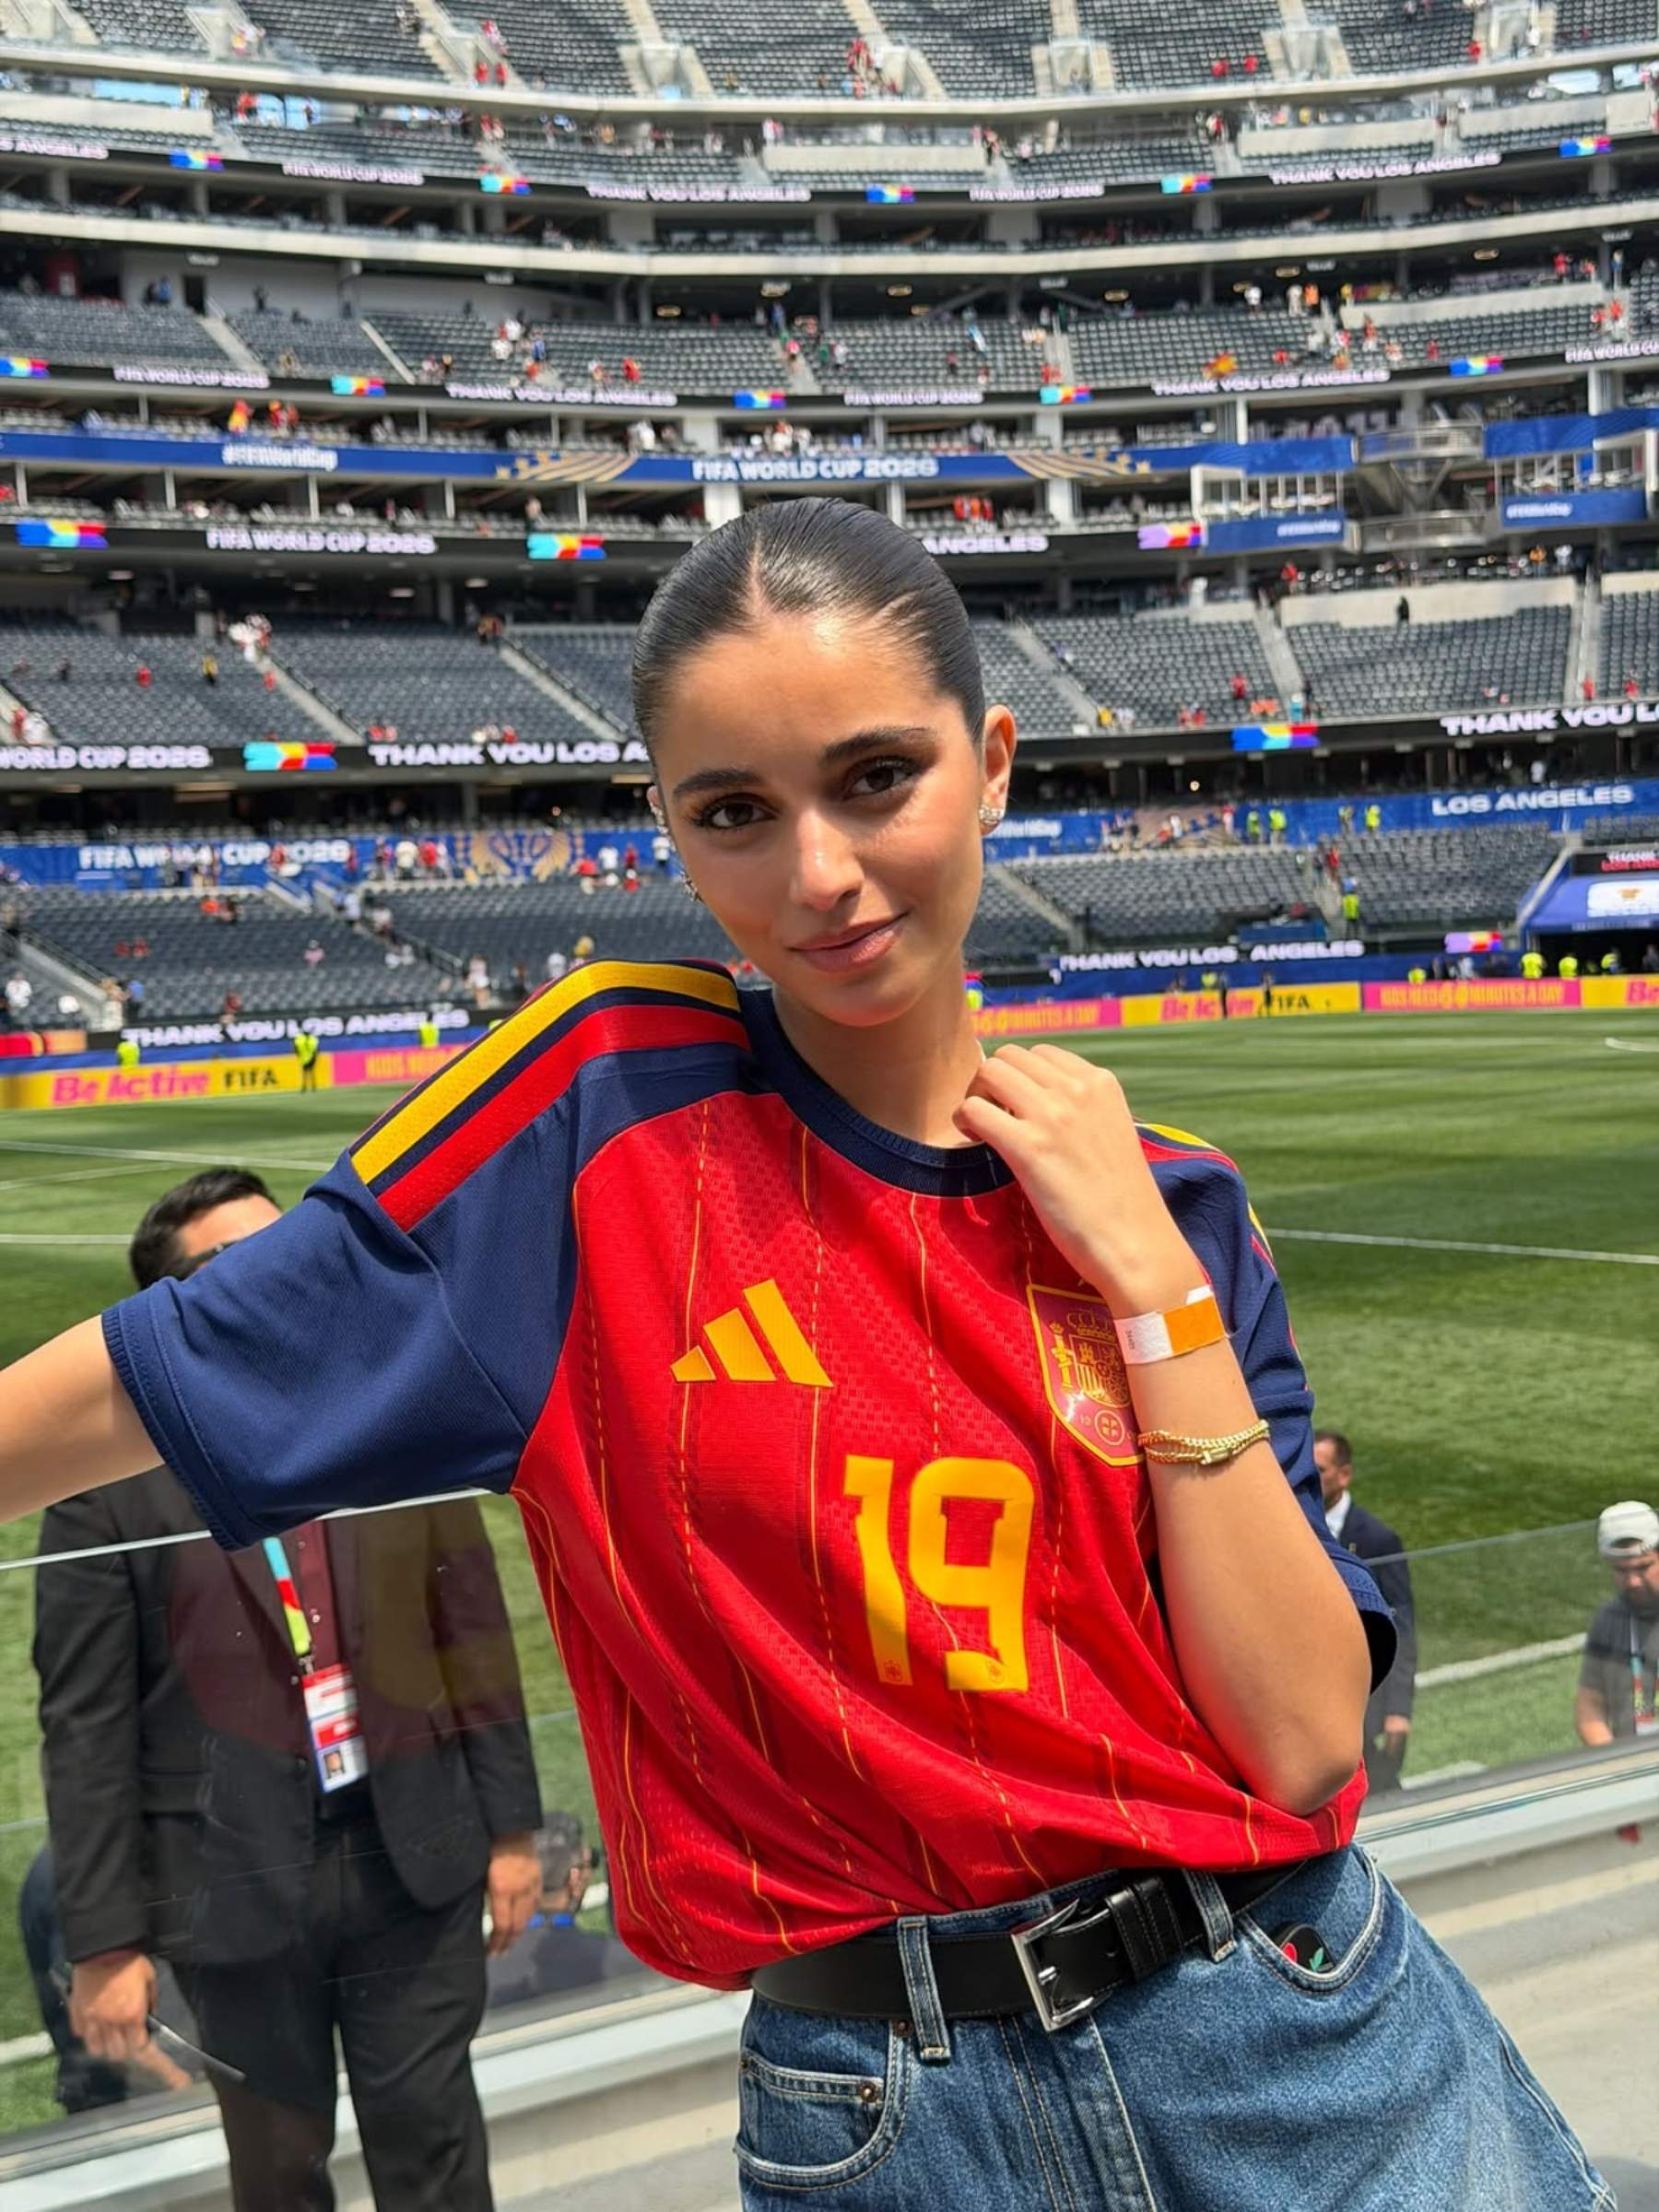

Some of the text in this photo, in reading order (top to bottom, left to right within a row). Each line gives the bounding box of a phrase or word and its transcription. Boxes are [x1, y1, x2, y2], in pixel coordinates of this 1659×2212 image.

[1269, 153, 1501, 184] THANK YOU LOS ANGELES
[446, 384, 512, 400] THANK
[514, 386, 552, 402] YOU
[594, 390, 677, 406] ANGELES
[1152, 371, 1390, 396] THANK YOU LOS ANGELES
[692, 457, 939, 480] FIFA WORLD CUP 2026
[206, 528, 253, 549] FIFA
[252, 529, 324, 551] WORLD
[325, 531, 366, 552] CUP
[923, 535, 1049, 555] ANGELES
[1440, 709, 1559, 736] THANK
[1560, 704, 1634, 728] YOU
[77, 745, 126, 769] CUP
[369, 744, 485, 766] THANK
[487, 741, 554, 764] YOU
[556, 741, 619, 764] LOS
[1431, 785, 1634, 816] LOS ANGELES
[78, 844, 135, 869] FIFA
[221, 841, 271, 865] CUP
[284, 839, 351, 864] 026
[1138, 949, 1189, 968] YOU
[1190, 946, 1238, 965] LOS
[1250, 940, 1364, 961] ANGELES
[122, 1024, 223, 1047] THANK
[226, 1019, 285, 1042] YOU
[287, 1017, 344, 1039] LOS
[53, 1065, 210, 1106] Be Active
[224, 1067, 277, 1088] FIFA
[843, 1454, 1034, 1694] 19
